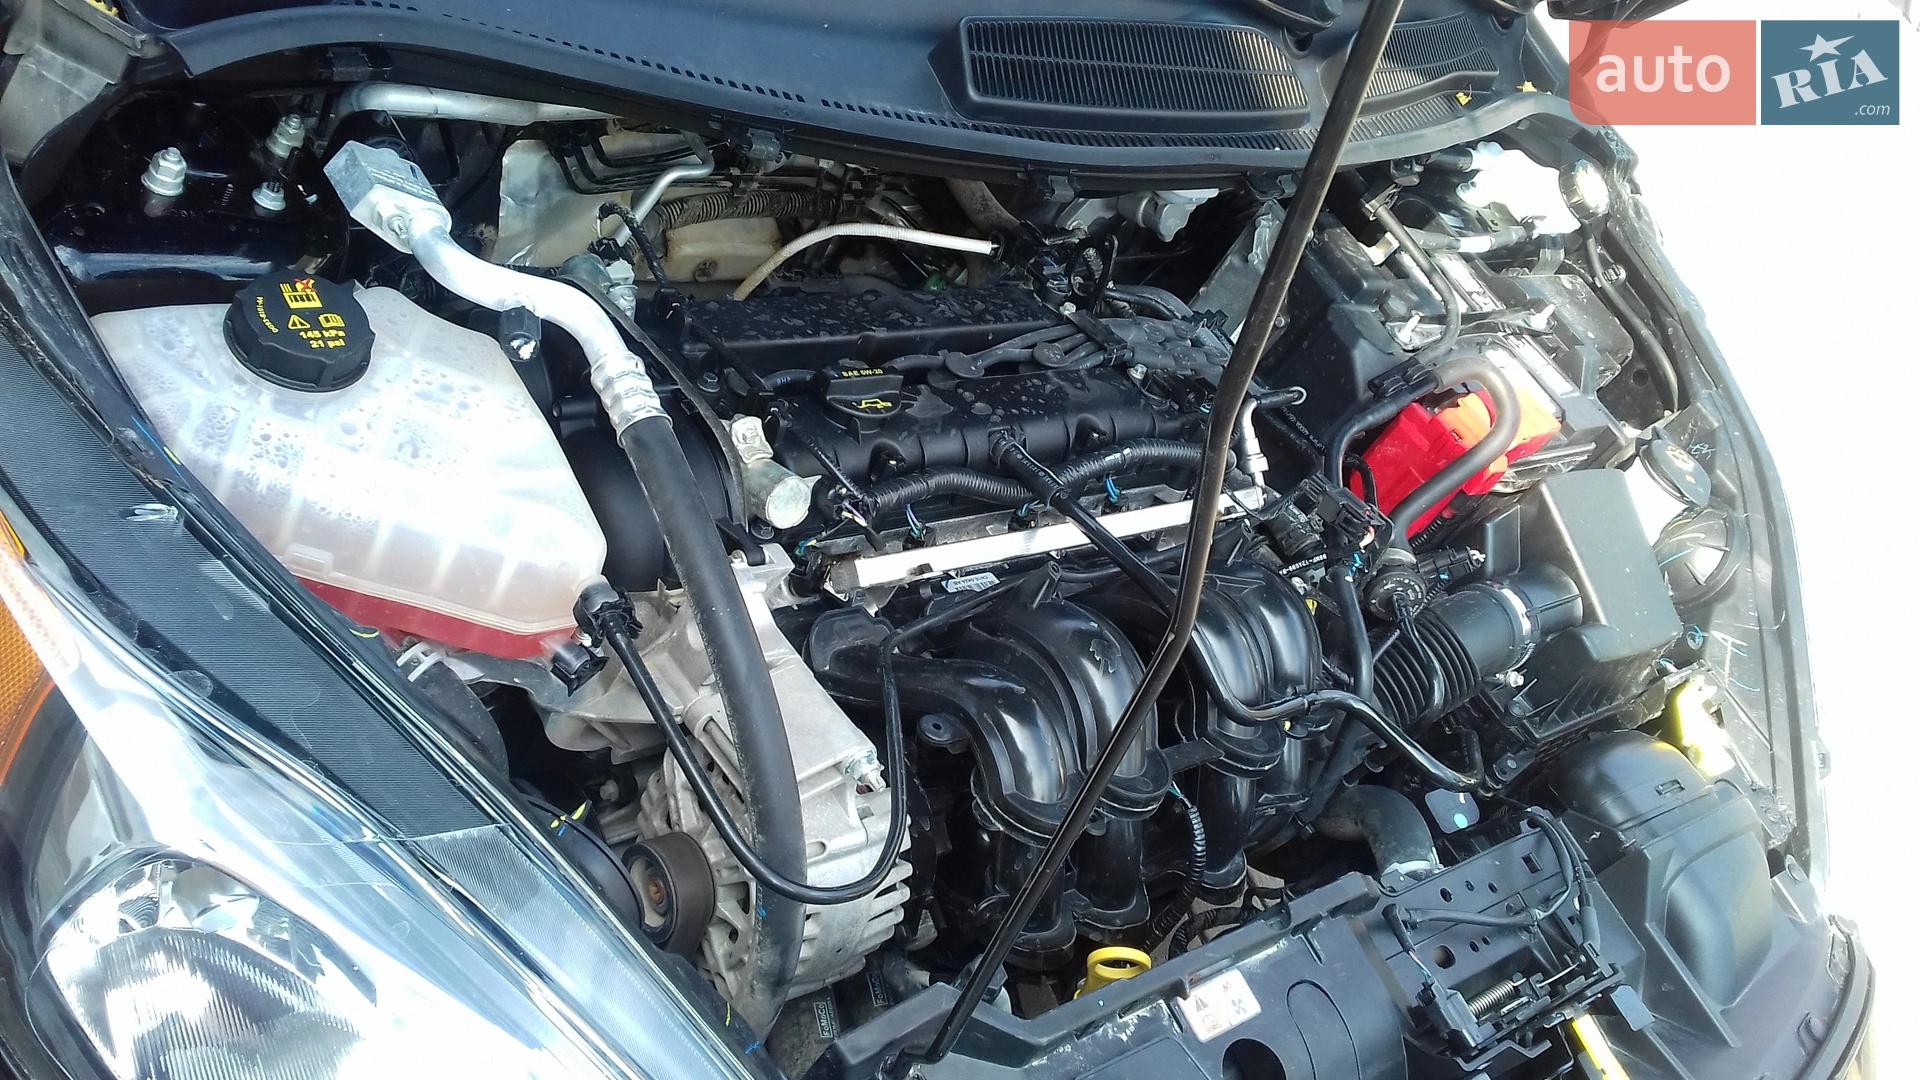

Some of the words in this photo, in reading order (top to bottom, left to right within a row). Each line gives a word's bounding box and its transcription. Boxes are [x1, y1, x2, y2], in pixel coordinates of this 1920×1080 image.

[299, 330, 321, 339] 145
[322, 329, 346, 338] kPa
[309, 339, 325, 348] 21
[326, 338, 346, 348] psi
[841, 369, 859, 377] SAE
[860, 368, 884, 376] 5W-20
[818, 1003, 831, 1036] FoMoCo
